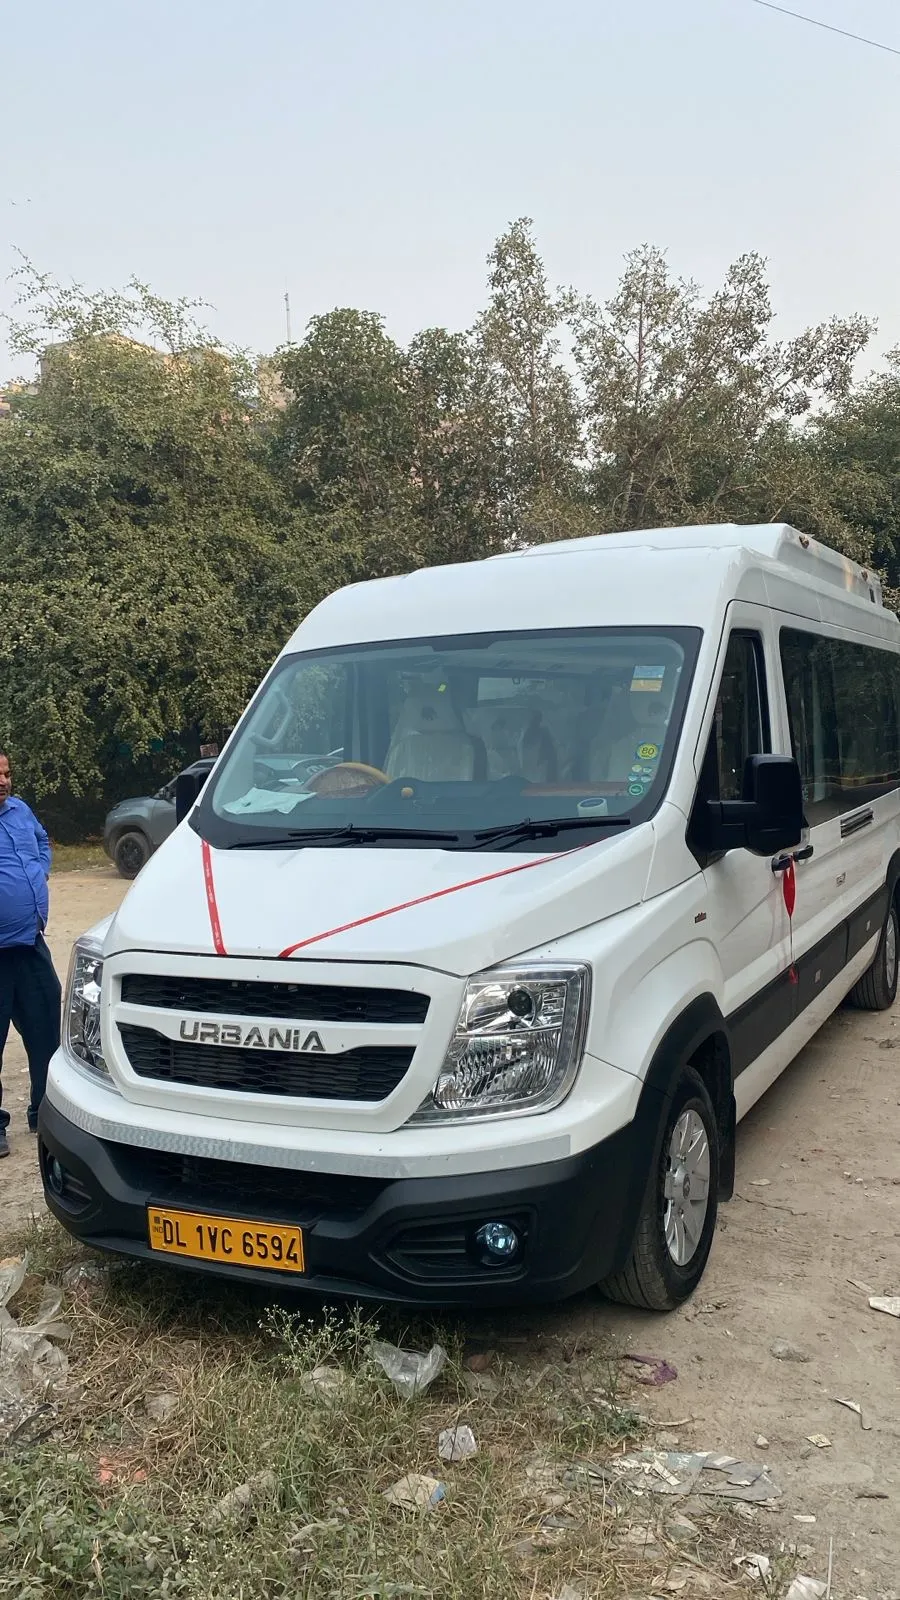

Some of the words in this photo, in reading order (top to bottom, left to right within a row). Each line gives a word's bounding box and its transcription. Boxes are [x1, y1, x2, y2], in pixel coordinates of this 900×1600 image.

[179, 1020, 326, 1052] URBANIA
[162, 1219, 187, 1248] DL
[195, 1225, 233, 1254] 1VC
[242, 1231, 298, 1264] 6594
